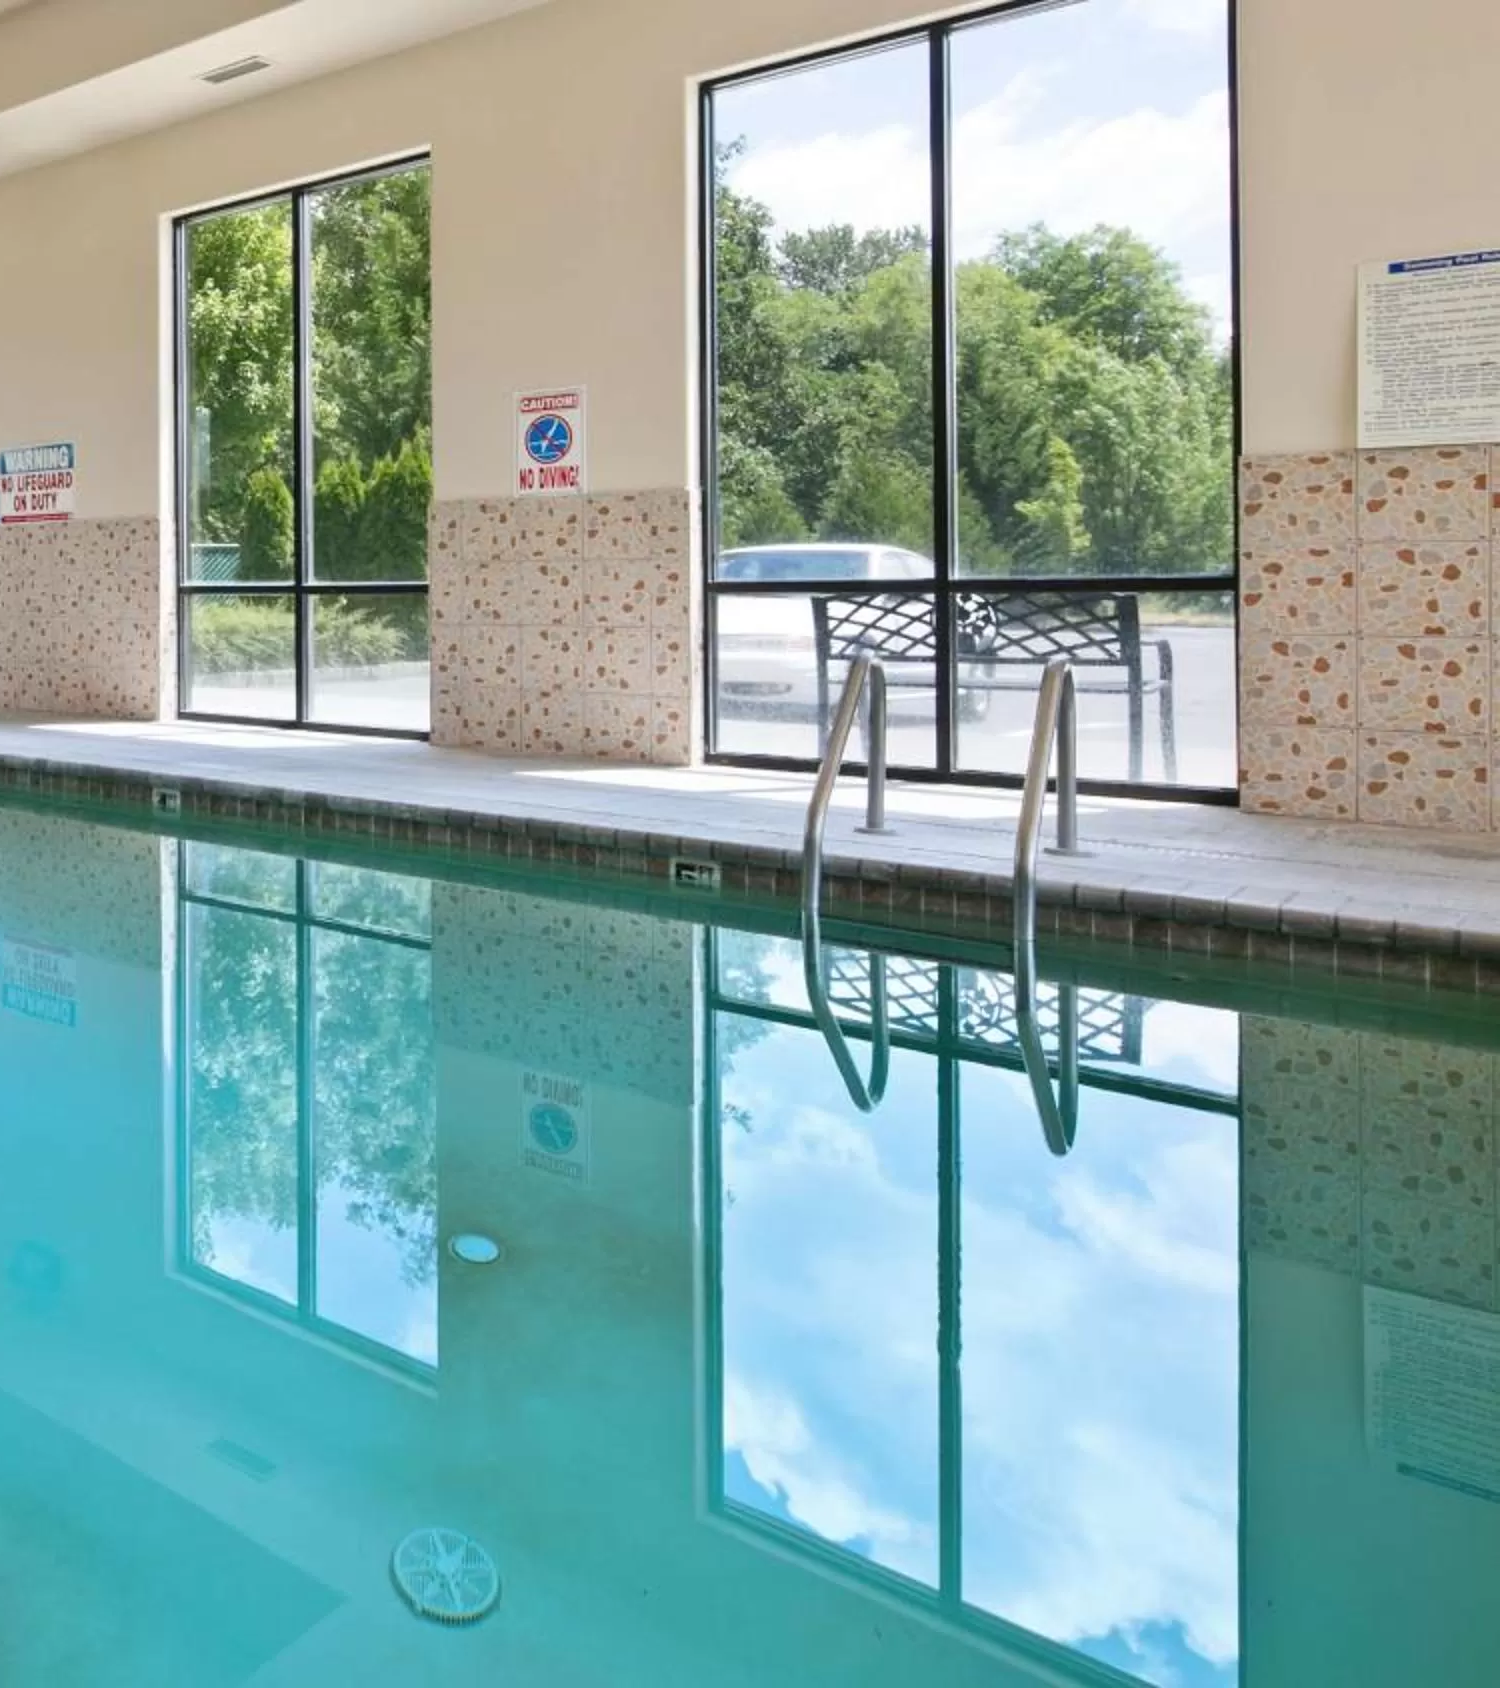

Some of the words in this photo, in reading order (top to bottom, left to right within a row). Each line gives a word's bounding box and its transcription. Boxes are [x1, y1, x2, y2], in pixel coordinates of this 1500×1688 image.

[522, 395, 578, 410] CAUTION!
[4, 446, 70, 472] WARNING
[1, 476, 13, 493] NO
[18, 472, 73, 492] LIFEGUARD
[519, 467, 534, 489] NO
[539, 464, 579, 489] DIVING!
[14, 495, 27, 512] ON
[31, 493, 57, 510] DUTY
